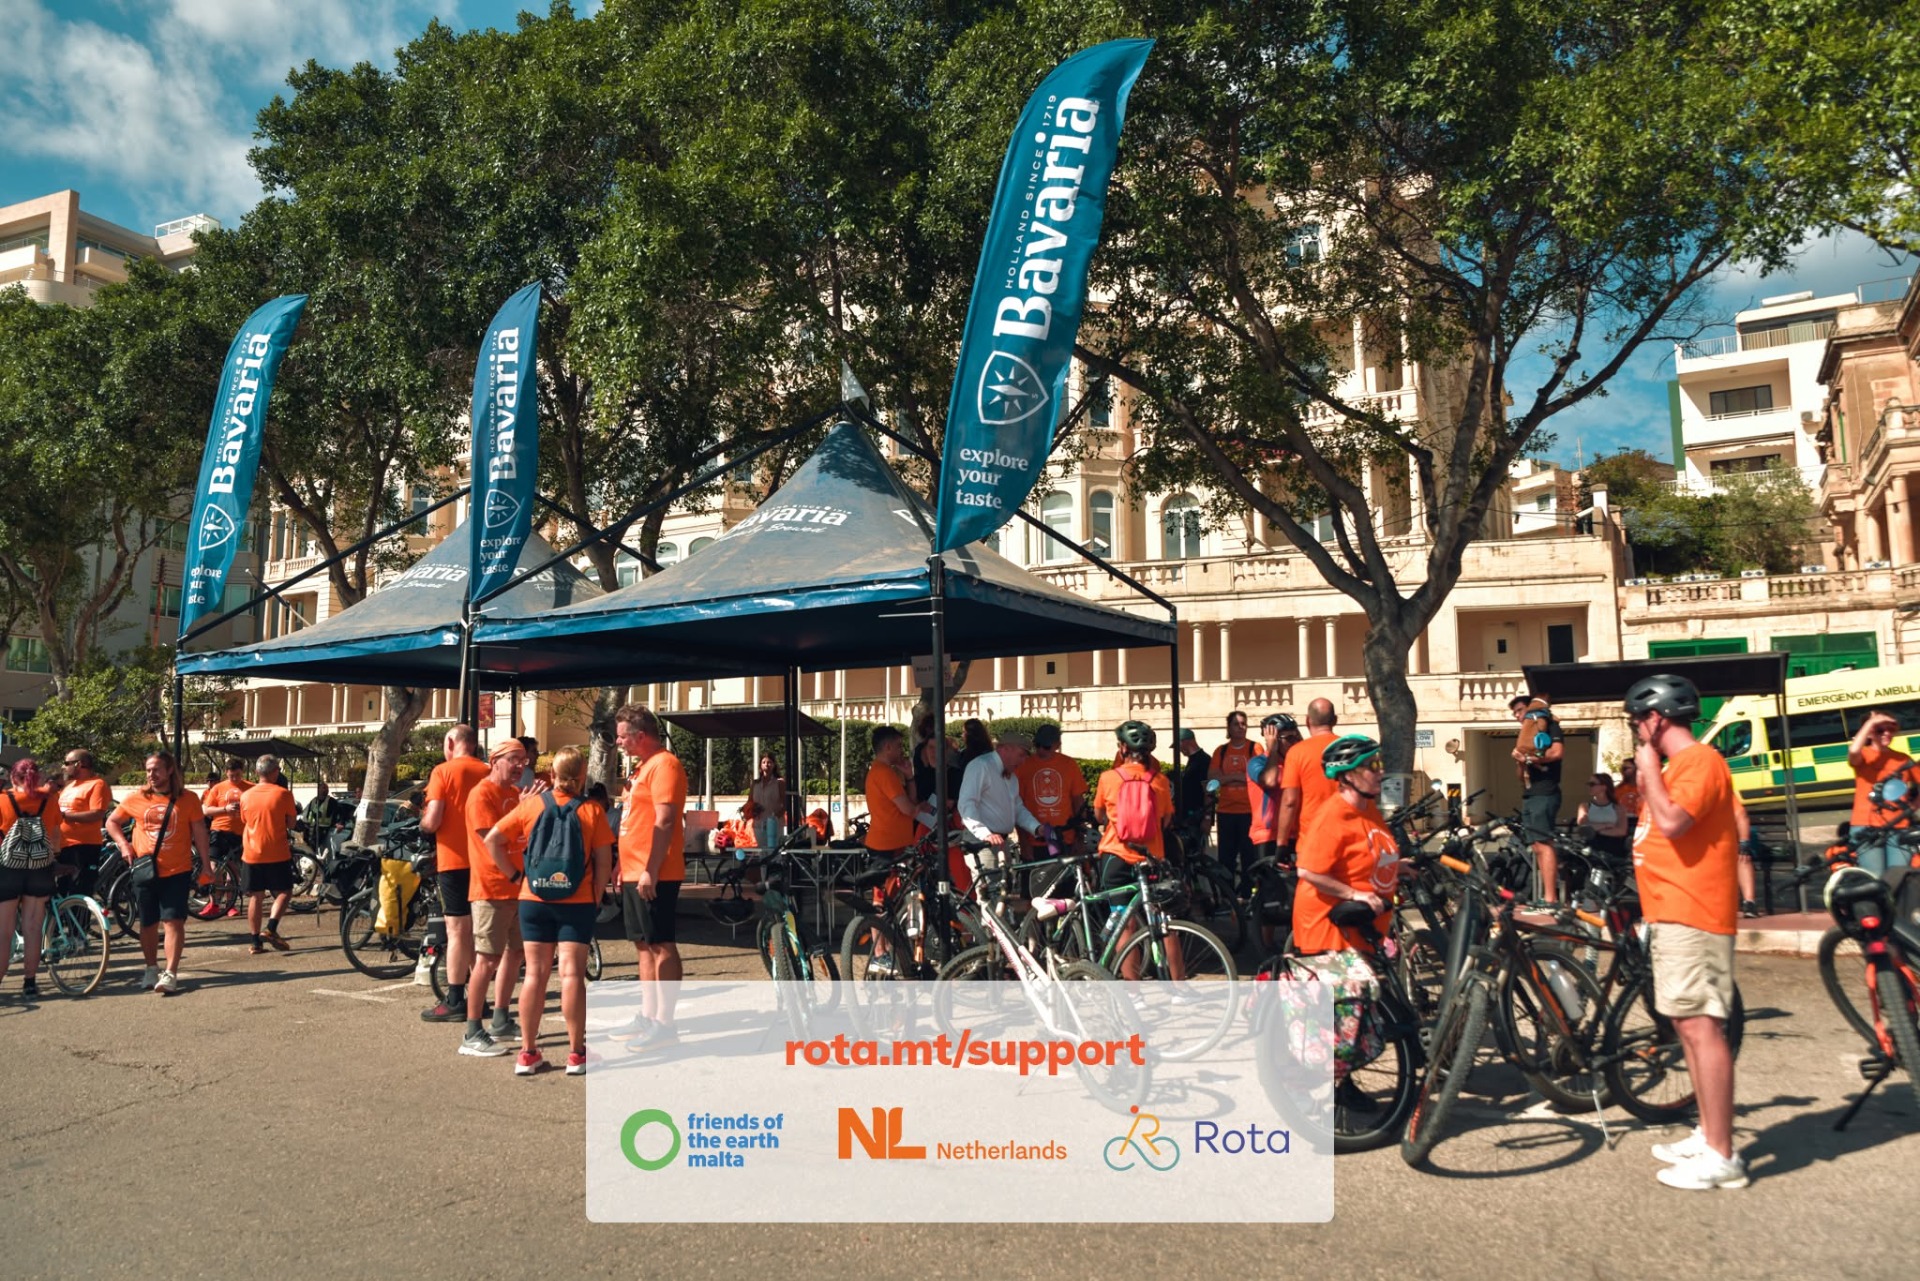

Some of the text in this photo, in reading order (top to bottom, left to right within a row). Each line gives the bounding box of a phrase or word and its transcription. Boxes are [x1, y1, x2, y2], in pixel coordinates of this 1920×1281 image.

[1005, 95, 1057, 289] HOLLAND SINCE 1719
[992, 97, 1100, 340] Bavaria
[208, 333, 272, 495] Bavaria
[216, 409, 231, 463] HOLLAND
[229, 368, 242, 403] SINCE
[489, 327, 519, 483] Bavaria
[960, 447, 1029, 471] explore
[956, 468, 1002, 485] your
[955, 488, 1002, 509] taste
[480, 550, 507, 563] your
[482, 563, 509, 575] taste
[1797, 684, 1920, 707] EMERGENCY AMBUL
